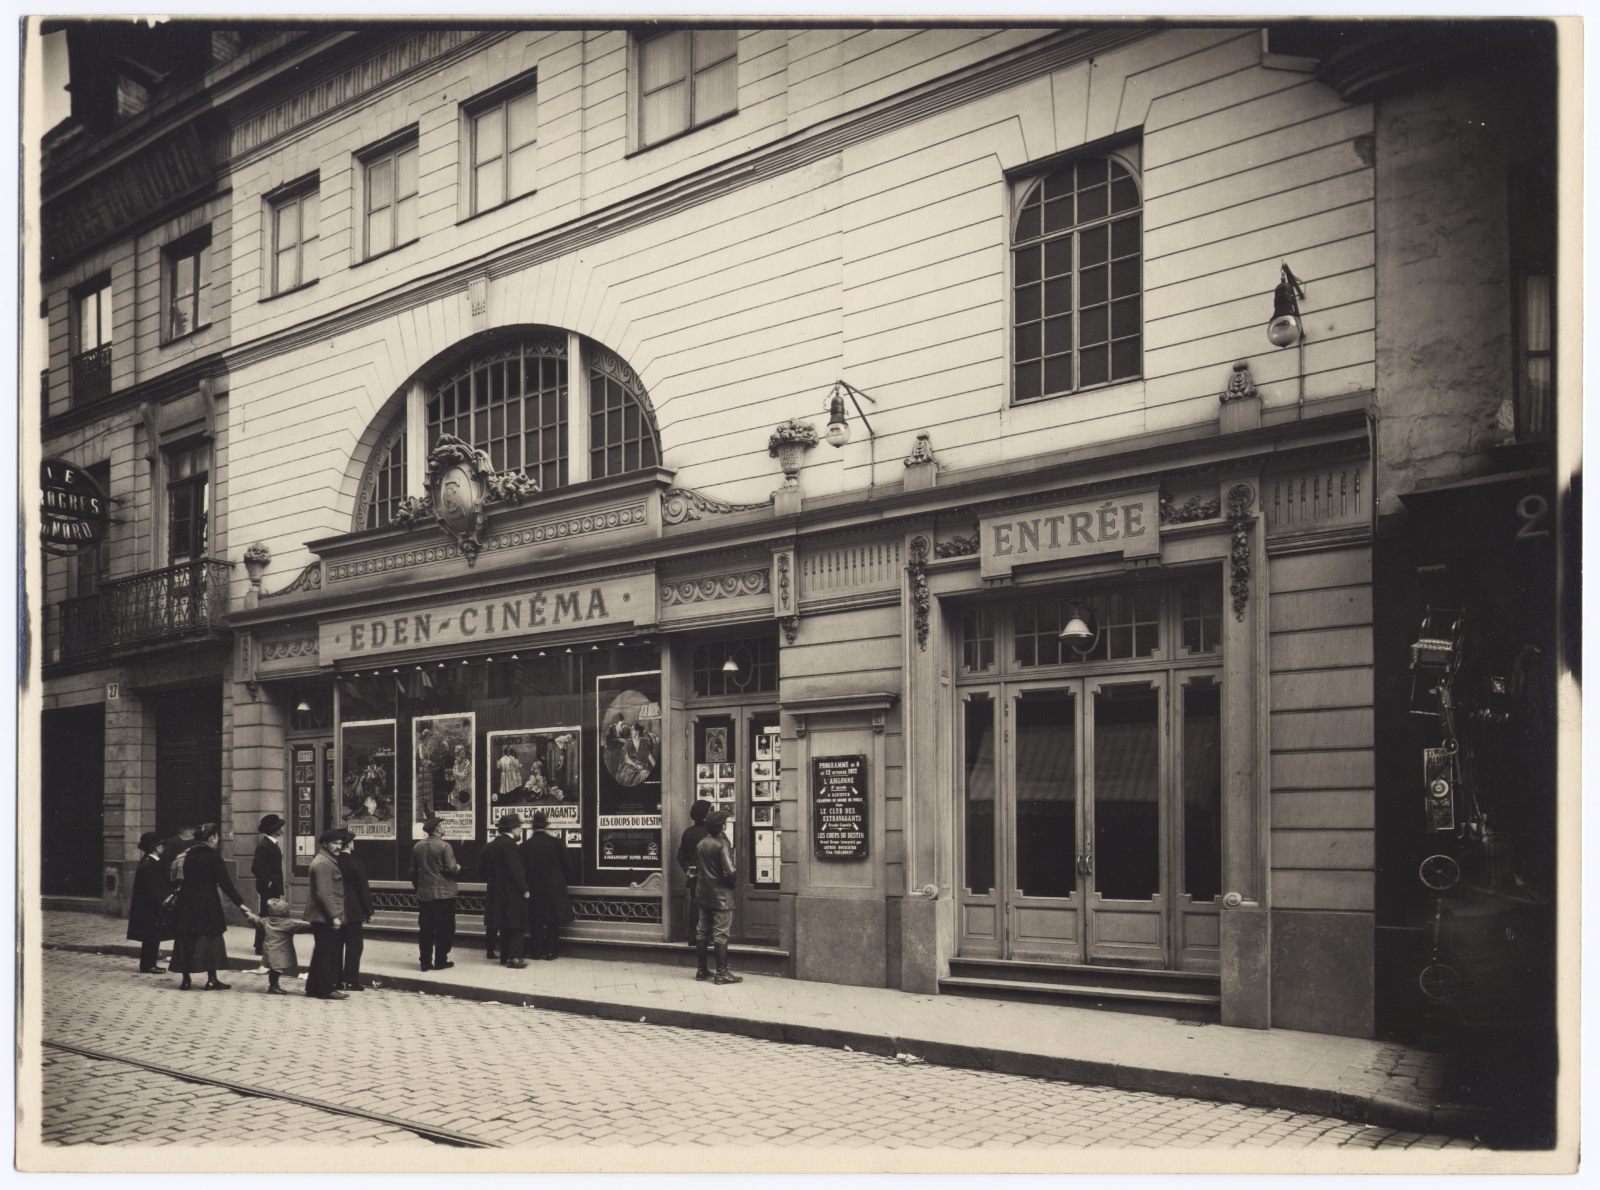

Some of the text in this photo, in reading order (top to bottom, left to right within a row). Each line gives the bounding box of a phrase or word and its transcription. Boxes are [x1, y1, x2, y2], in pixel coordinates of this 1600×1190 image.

[1516, 494, 1550, 540] 2
[52, 521, 92, 540] NORD
[992, 502, 1146, 556] ENTRÉE
[109, 684, 117, 698] 27
[524, 807, 576, 818] EXTAVAGANTS
[600, 817, 610, 826] LES
[611, 817, 630, 826] COUPS
[632, 817, 640, 826] DU
